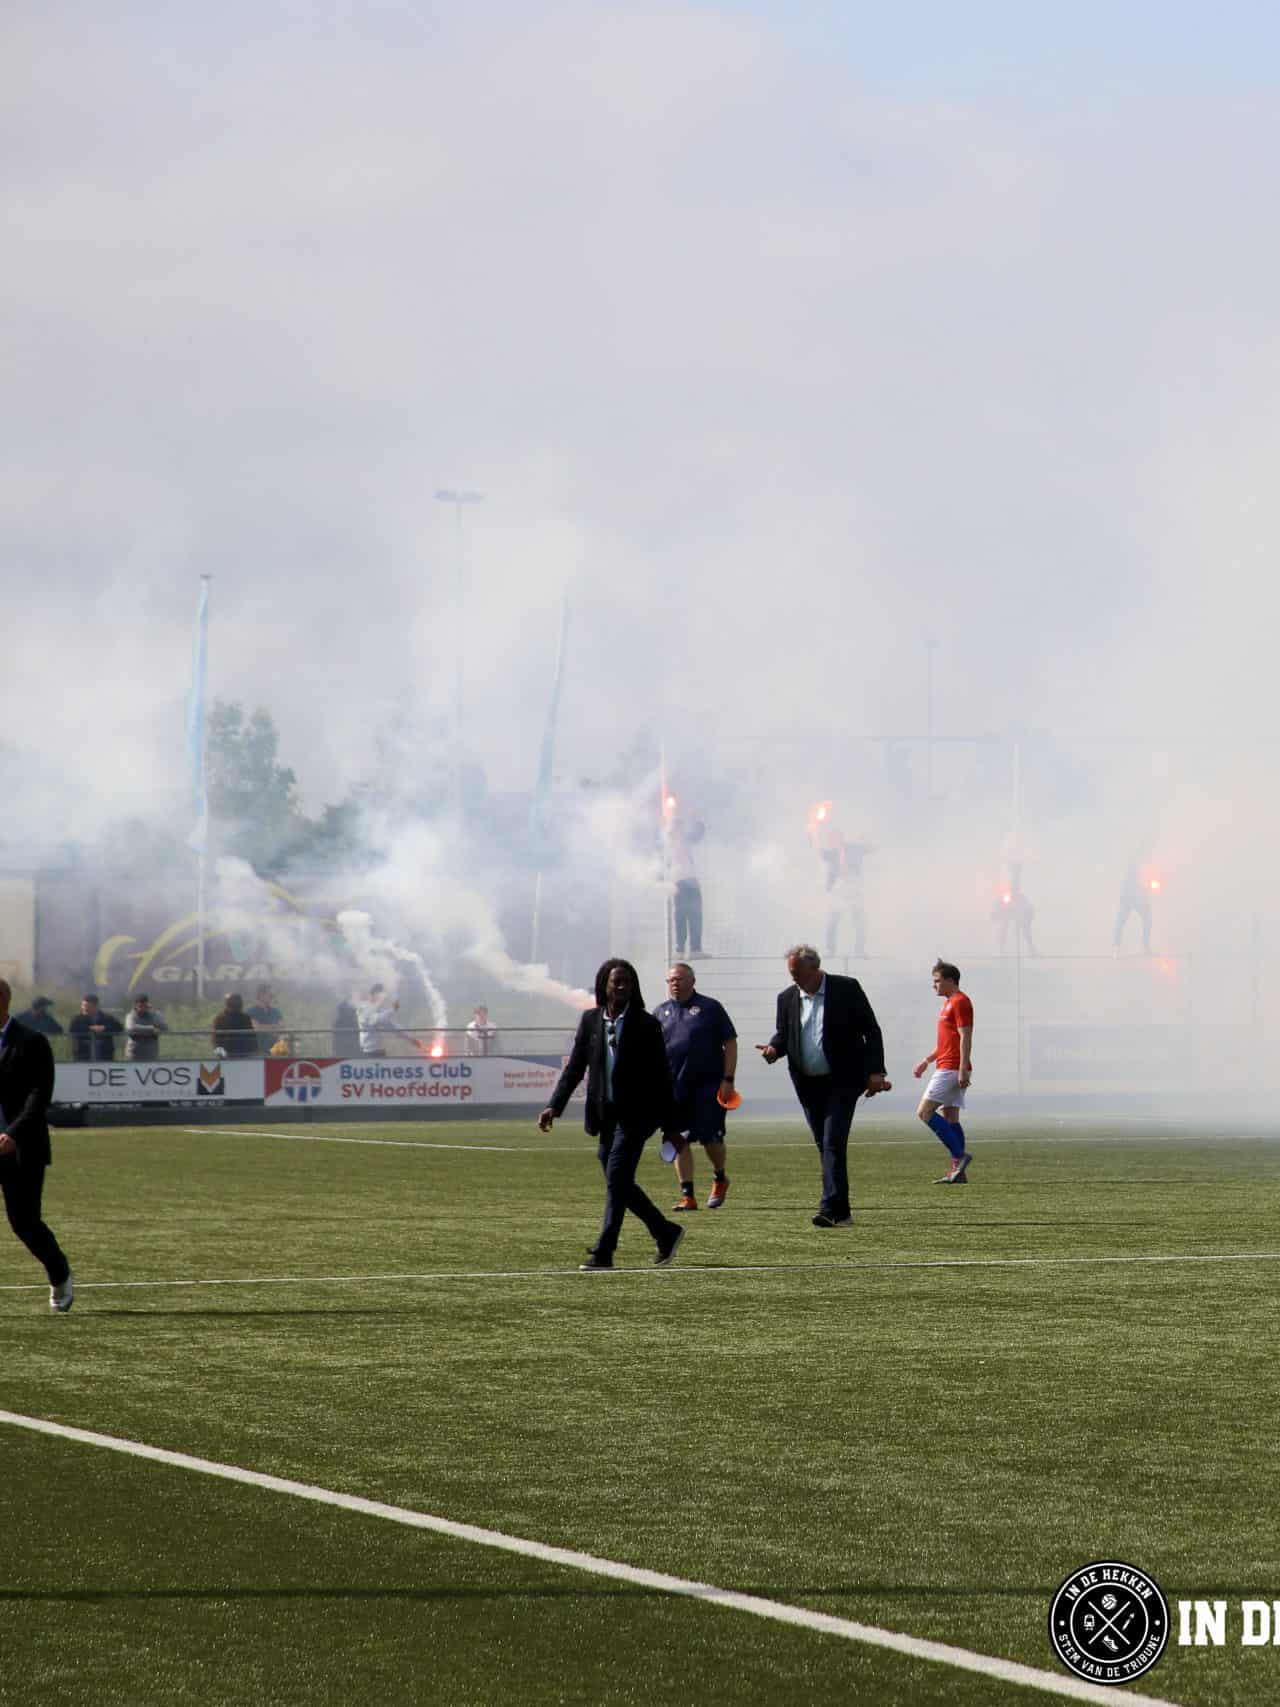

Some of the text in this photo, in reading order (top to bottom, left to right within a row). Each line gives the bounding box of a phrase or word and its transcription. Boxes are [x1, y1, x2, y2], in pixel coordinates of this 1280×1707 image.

[88, 1067, 191, 1087] DE VOS
[340, 1063, 473, 1080] Business Club
[341, 1082, 473, 1101] SV Hoofddorp
